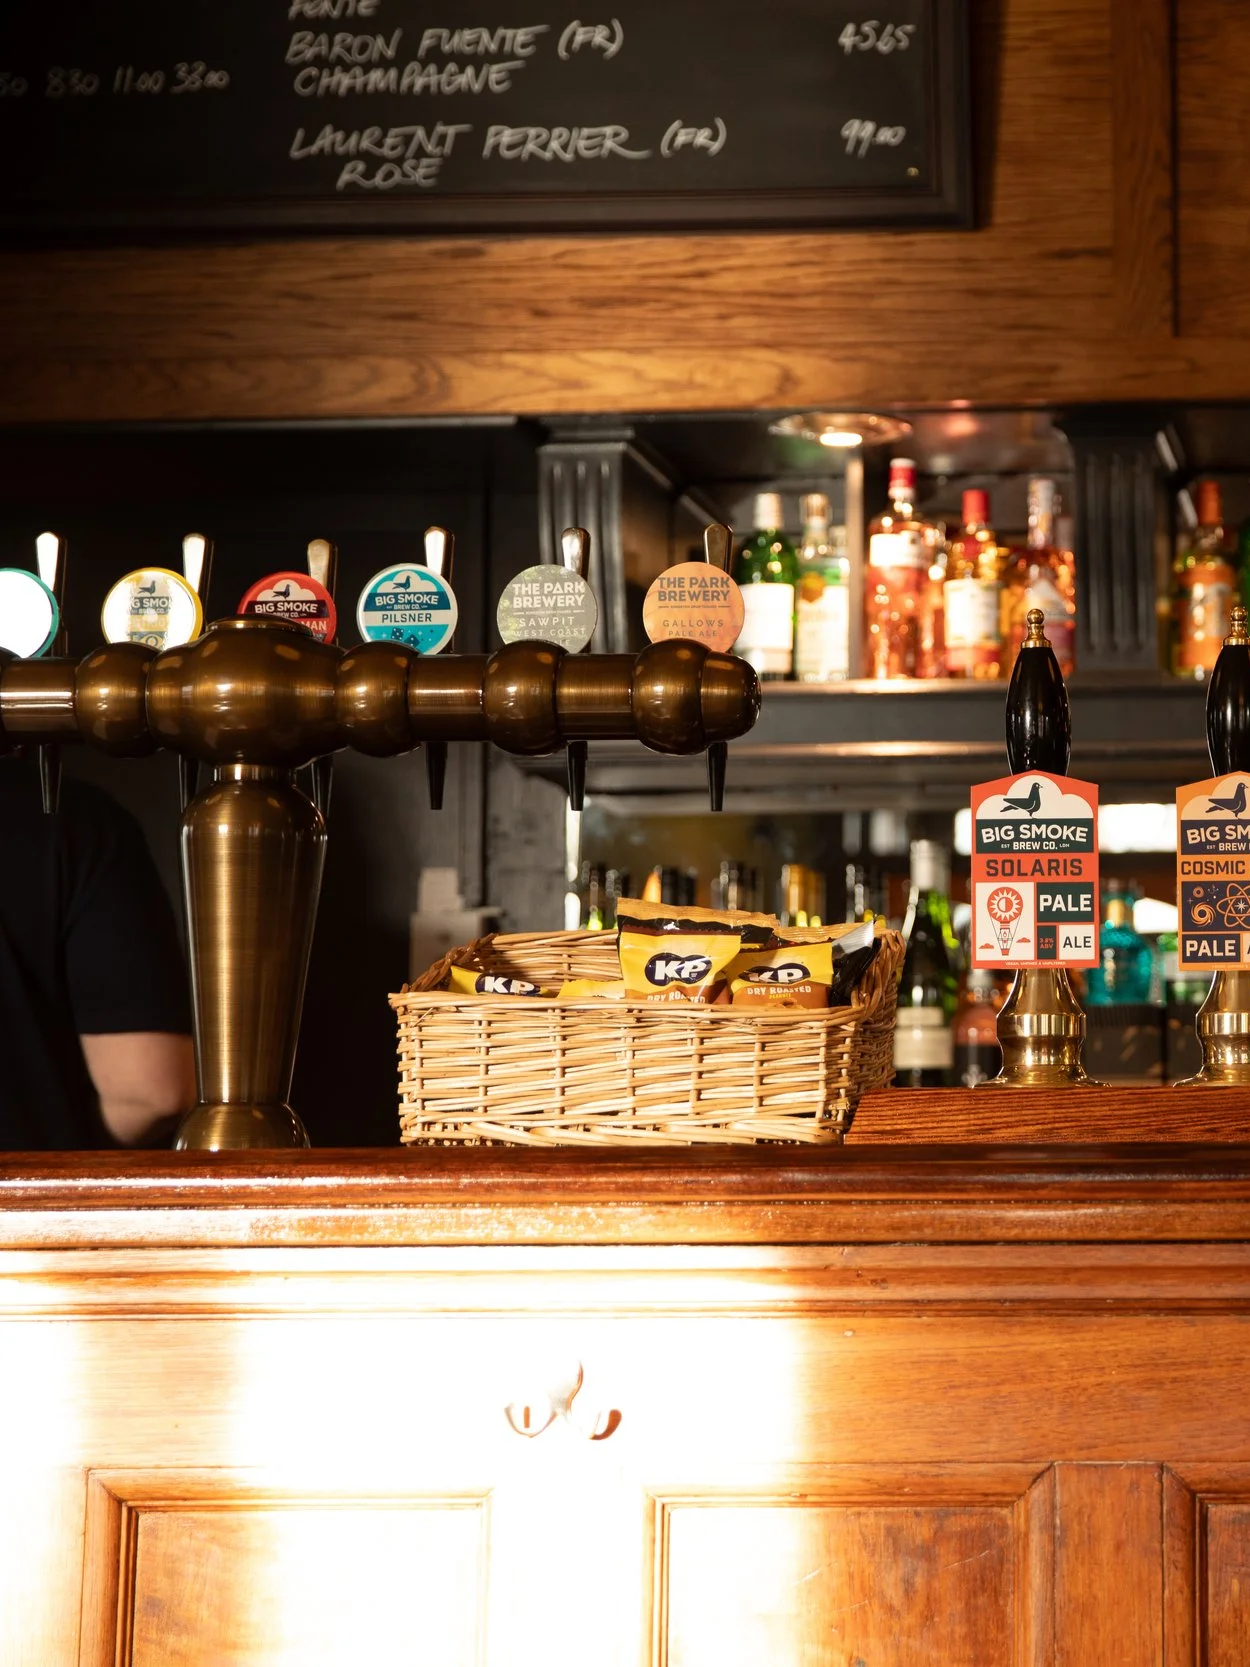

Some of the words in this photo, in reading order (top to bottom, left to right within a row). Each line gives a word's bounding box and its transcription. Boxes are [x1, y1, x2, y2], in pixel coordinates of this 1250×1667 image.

[285, 28, 402, 64] BARON
[418, 24, 551, 60] FUENTE
[558, 18, 624, 60] (FR)
[294, 60, 526, 97] CHAMPAGNE
[289, 121, 473, 159] LAURENT
[482, 124, 652, 162] PERRIER
[661, 116, 727, 158] (FR)
[336, 157, 443, 191] ROSE
[512, 583, 540, 595] THE
[544, 581, 585, 594] PARK
[658, 577, 685, 588] THE
[689, 576, 730, 588] PARK
[375, 595, 395, 606] BIG
[397, 593, 439, 605] SMOKE
[513, 595, 585, 609] BREWERY
[658, 590, 730, 602] BREWERY
[254, 603, 275, 613] BIG
[277, 602, 318, 613] SMOKE
[382, 613, 432, 623] PILSNER
[519, 616, 575, 627] SAWPIT
[662, 619, 724, 628] GALLOWS
[515, 629, 544, 637] WEST
[550, 628, 586, 637] COAST
[981, 826, 1015, 844] BIG
[1019, 824, 1088, 842] SMOKE
[1186, 826, 1220, 844] BIG
[1013, 841, 1041, 850] BREW
[1043, 841, 1058, 850] CO.
[1219, 842, 1247, 851] BREW
[985, 858, 1083, 877] SOLARIS
[1181, 860, 1246, 876] COSMIC
[1039, 894, 1091, 912] PALE
[1063, 936, 1092, 948] ALE
[1185, 940, 1236, 957] PALE
[655, 960, 707, 980] KP
[748, 968, 803, 983] KP
[484, 976, 535, 994] KP
[747, 987, 766, 995] DRY
[769, 985, 812, 995] ROASTED
